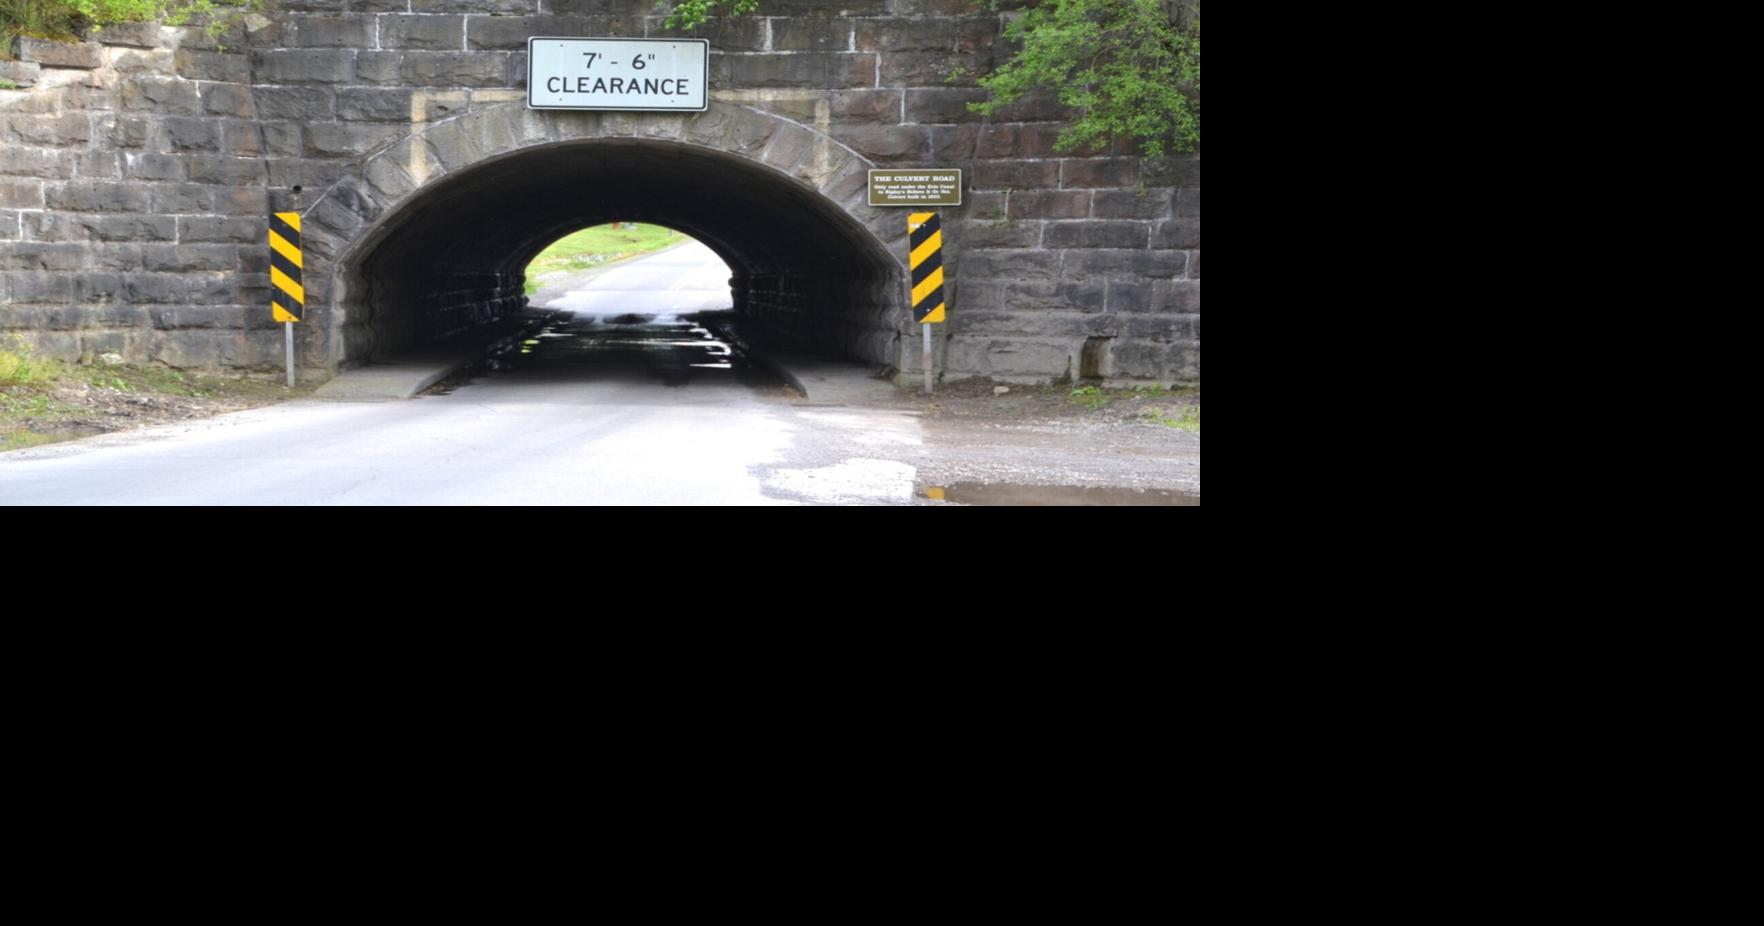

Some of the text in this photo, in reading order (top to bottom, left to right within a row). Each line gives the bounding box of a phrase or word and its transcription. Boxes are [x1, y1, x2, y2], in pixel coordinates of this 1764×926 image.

[582, 52, 602, 69] 7'
[632, 54, 655, 70] 6"
[547, 77, 689, 95] CLEARANCE
